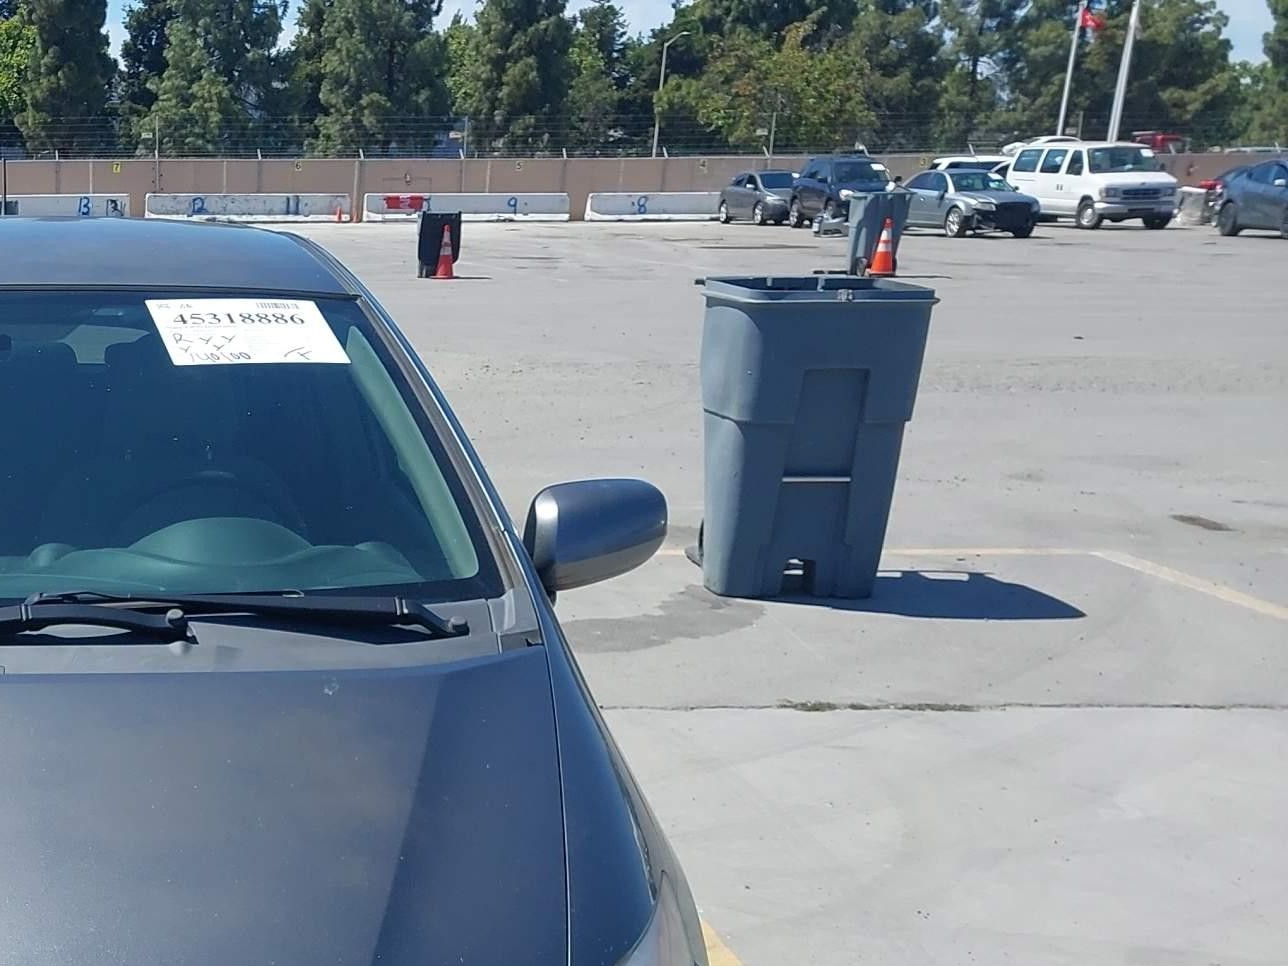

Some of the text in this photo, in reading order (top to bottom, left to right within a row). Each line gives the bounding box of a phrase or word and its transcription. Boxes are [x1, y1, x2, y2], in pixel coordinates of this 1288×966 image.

[113, 163, 120, 172] 7
[507, 197, 518, 215] 9
[637, 196, 648, 214] 8
[173, 312, 305, 325] 45318886
